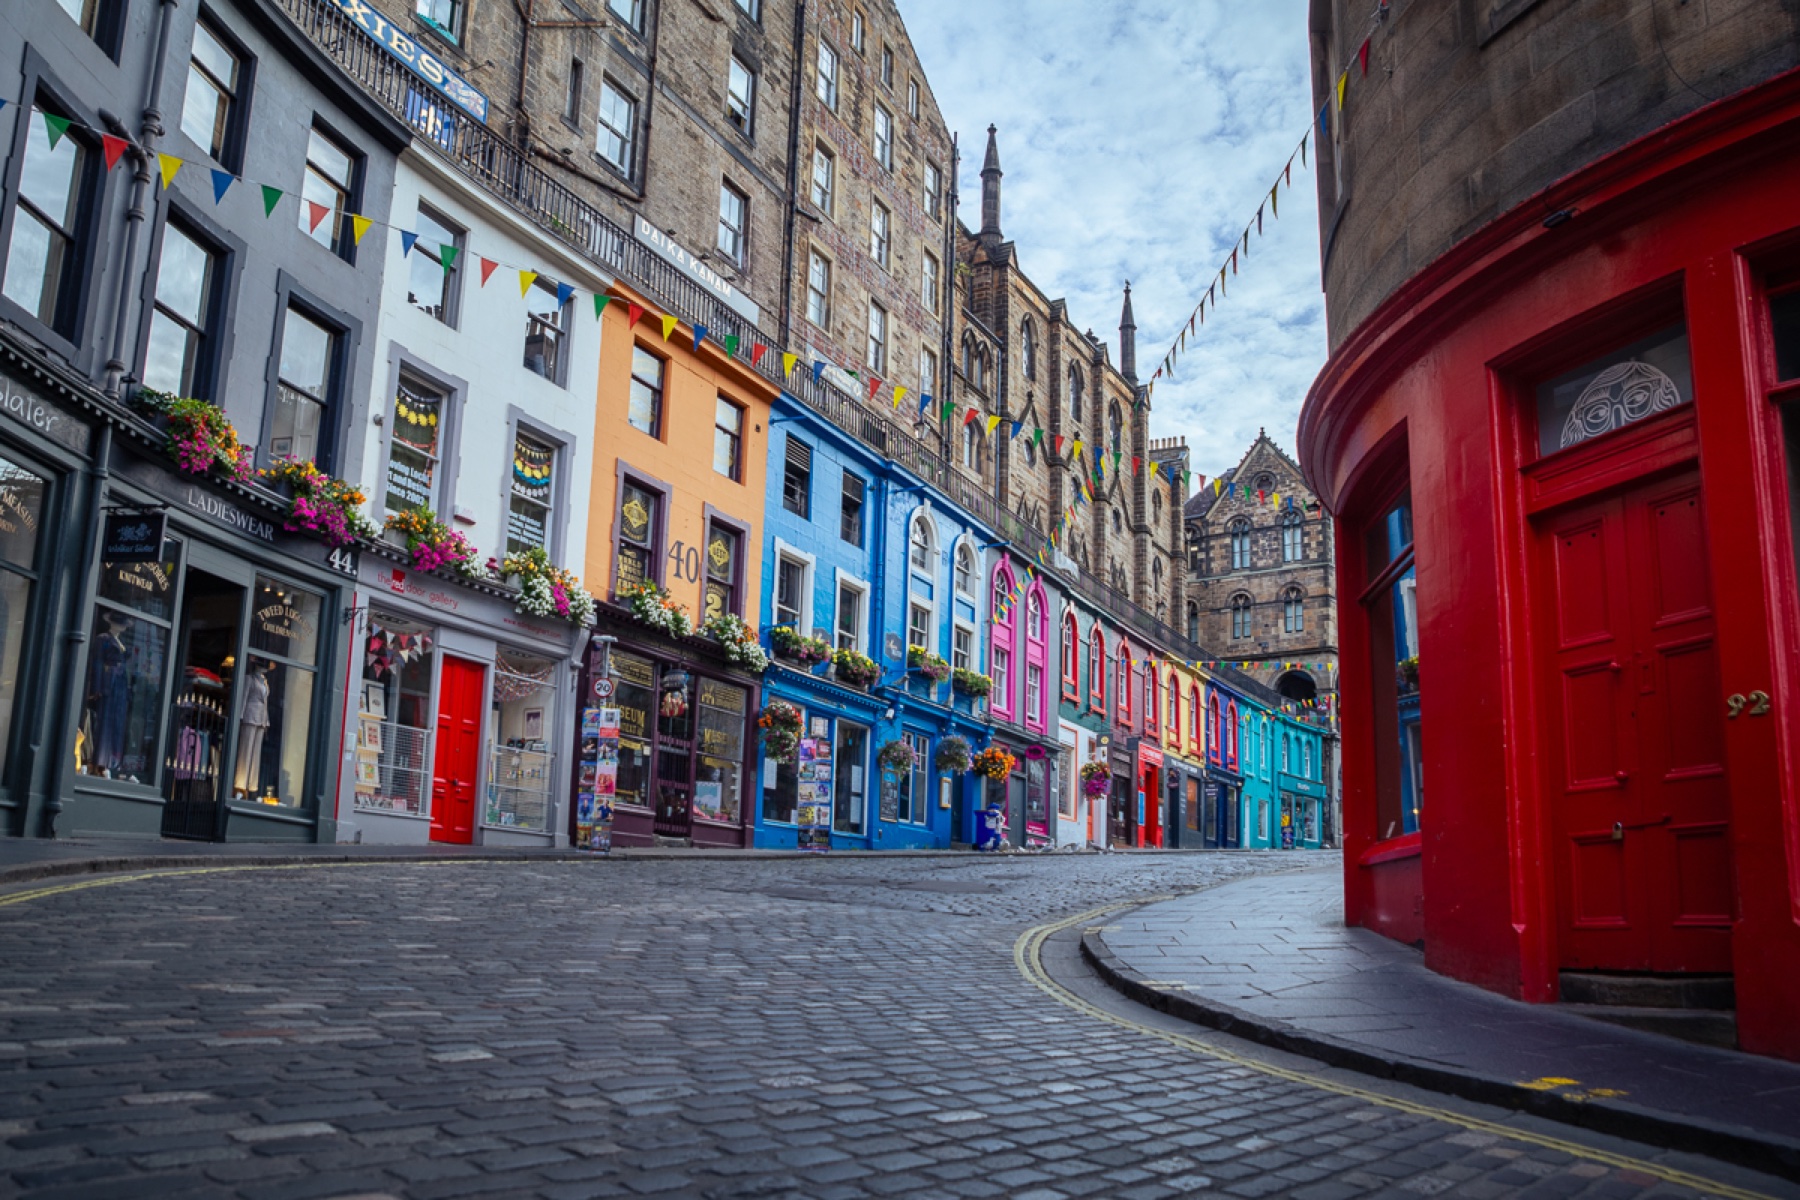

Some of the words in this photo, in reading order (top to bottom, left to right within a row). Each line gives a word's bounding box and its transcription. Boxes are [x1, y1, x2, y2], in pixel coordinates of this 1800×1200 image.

[188, 489, 274, 541] LADIESWEAR
[668, 540, 700, 584] 40
[377, 571, 393, 586] the
[406, 581, 427, 597] door
[428, 591, 459, 610] gallery
[596, 683, 611, 693] 20
[1727, 689, 1771, 718] 92
